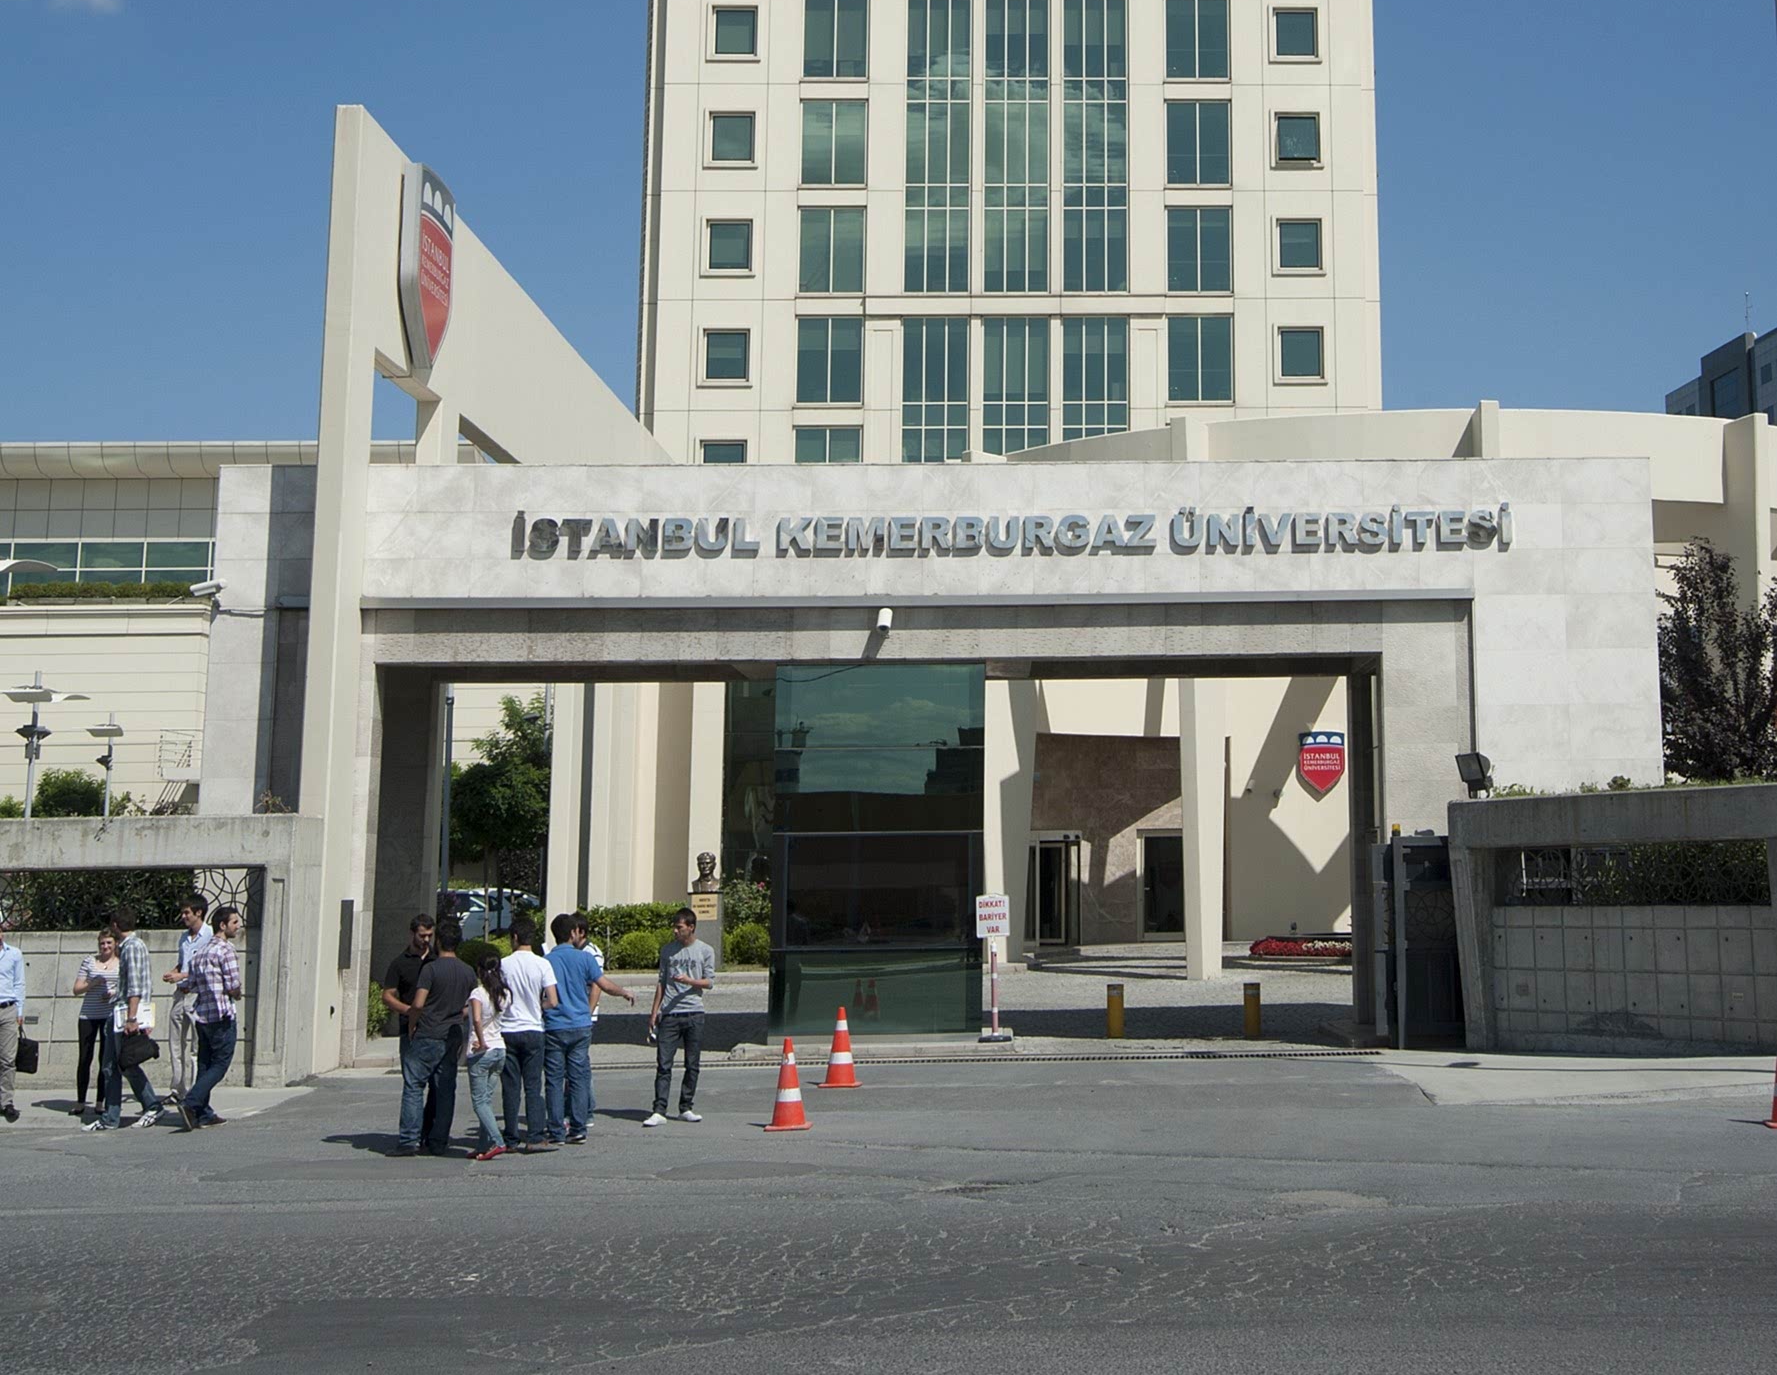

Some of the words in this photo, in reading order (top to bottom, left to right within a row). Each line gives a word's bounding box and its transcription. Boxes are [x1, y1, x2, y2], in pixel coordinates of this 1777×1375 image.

[511, 510, 760, 559] İSTANBUL
[775, 514, 1156, 558] KEMERBURGAZ
[1169, 502, 1513, 555] ÜNİVERSİTESİ
[978, 900, 1005, 908] DİKKAT!
[978, 912, 1007, 921] BARİYER
[986, 925, 1000, 933] VAR
